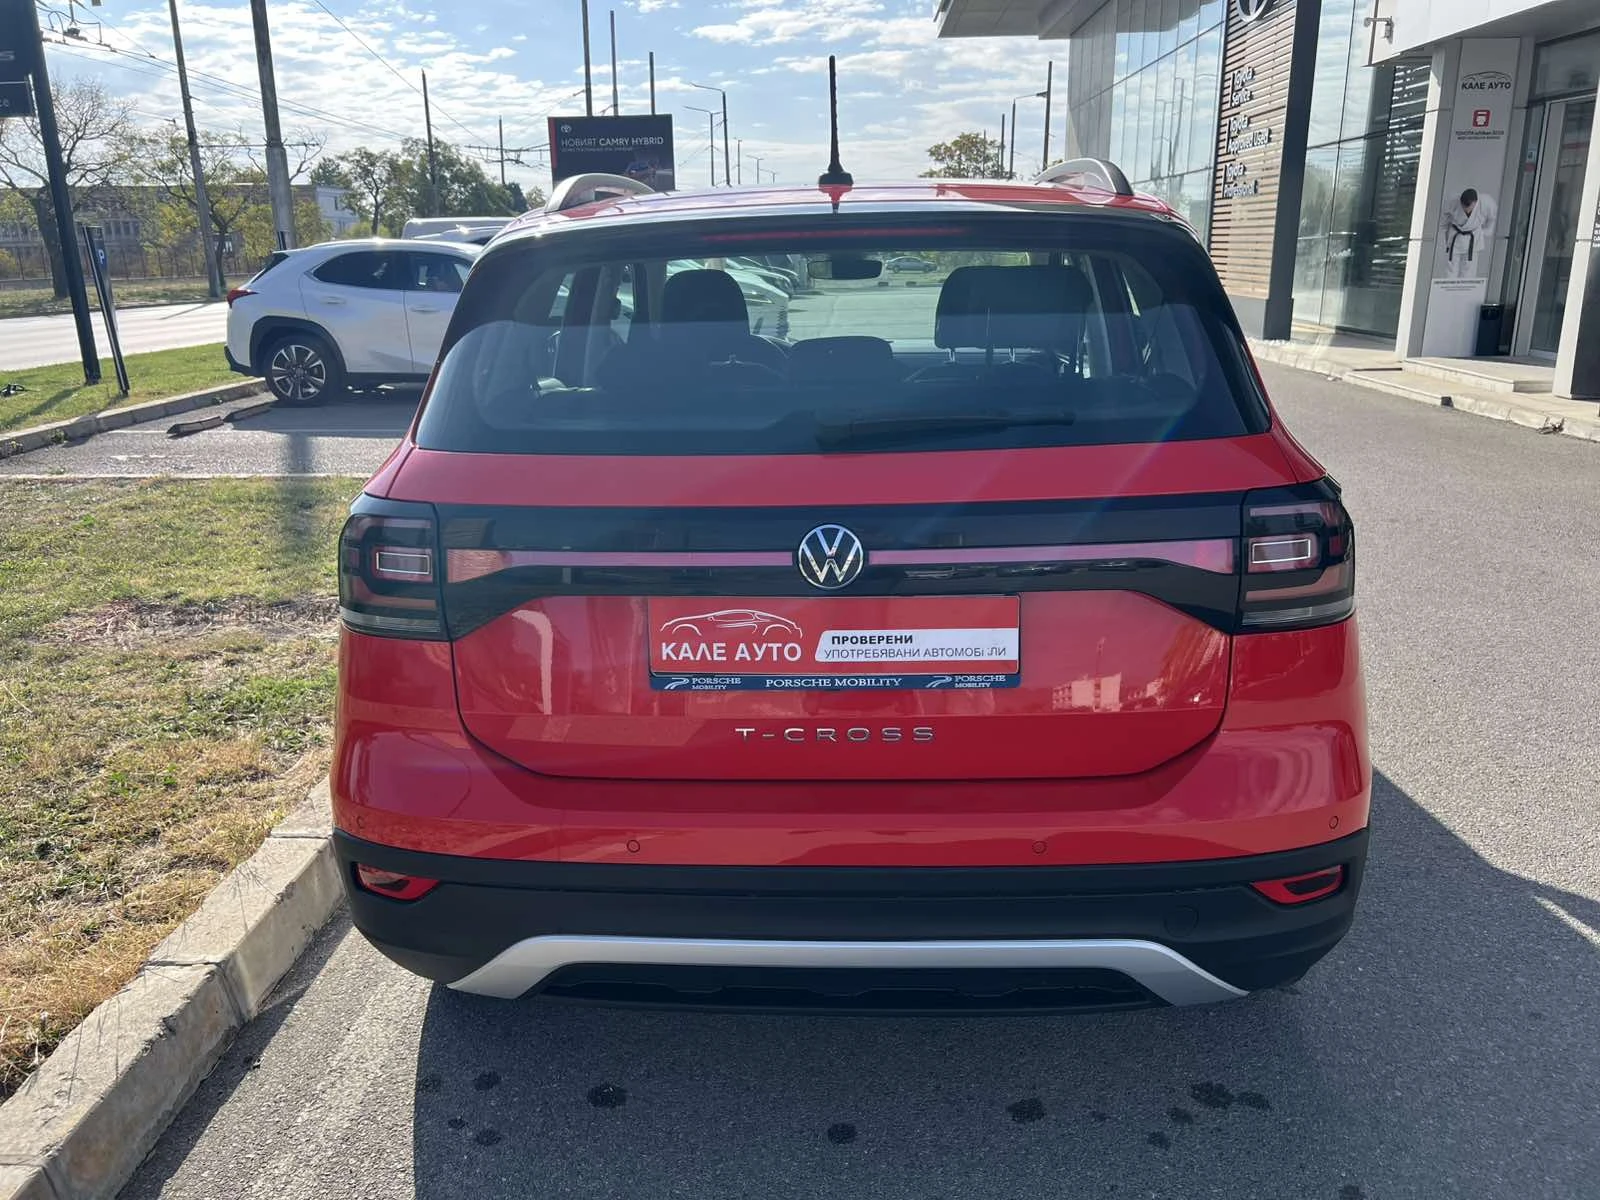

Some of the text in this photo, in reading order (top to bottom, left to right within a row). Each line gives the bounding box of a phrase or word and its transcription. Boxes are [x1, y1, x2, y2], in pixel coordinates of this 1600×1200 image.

[1234, 67, 1253, 88] Toyota
[1232, 88, 1251, 106] Service
[1230, 115, 1248, 135] Toyota
[599, 137, 629, 146] CAMRY
[631, 136, 664, 145] HYBRID
[1228, 128, 1269, 156] Approved Used
[1226, 162, 1244, 181] Toyota
[1224, 180, 1255, 198] Professional
[831, 635, 913, 645] ПРОВЕРЕНИ
[661, 642, 802, 662] КАЛЕ АУТО
[824, 648, 920, 659] УПОТРЕБЯВАНИ
[765, 677, 902, 688] PORSCHE MOBILITY
[954, 674, 1006, 682] PORSCHE
[735, 727, 934, 743] T-CROSS
